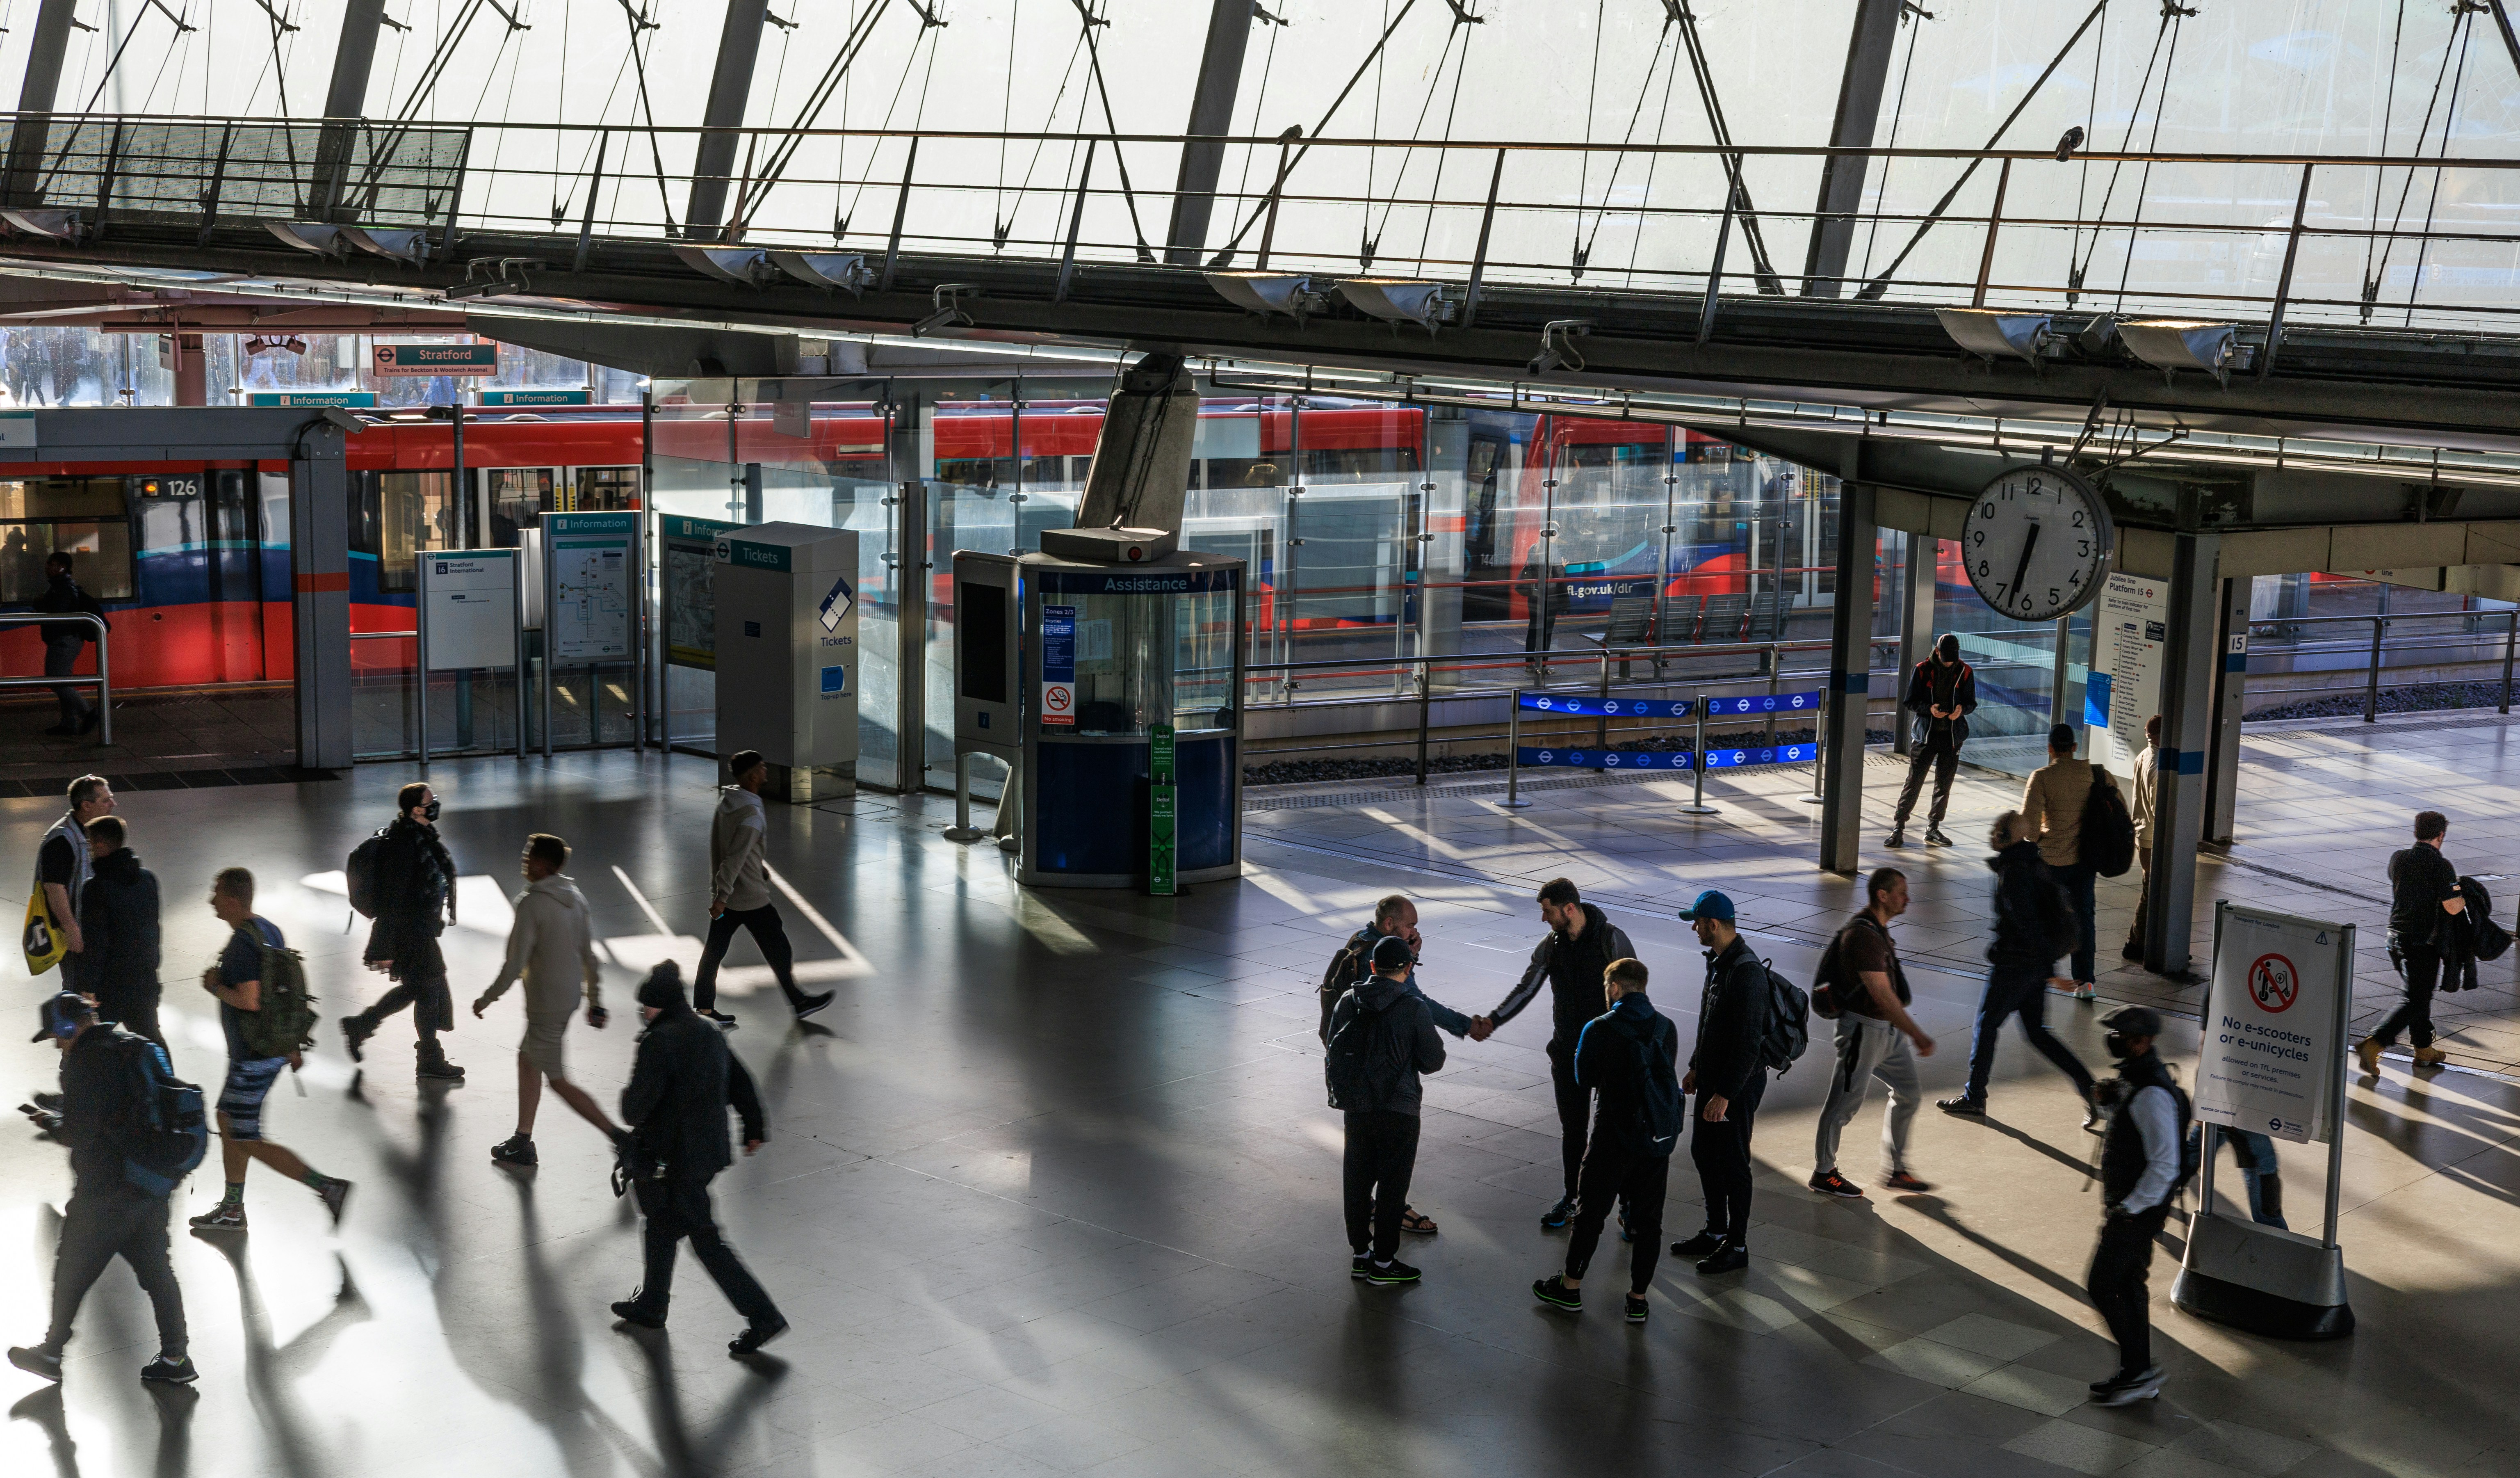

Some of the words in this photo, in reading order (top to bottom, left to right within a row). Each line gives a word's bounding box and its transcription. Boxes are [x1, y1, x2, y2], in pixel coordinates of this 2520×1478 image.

[420, 350, 471, 360] Stratford
[168, 480, 196, 496] 126
[2002, 483, 2014, 500] 11
[2027, 477, 2042, 495] 12
[2058, 487, 2062, 504] 1
[1981, 502, 1995, 519] 10
[2072, 510, 2084, 528] 2
[570, 519, 627, 528] Information
[1974, 531, 1985, 548] 9
[743, 547, 778, 564] Tickets
[2078, 540, 2089, 557] 3
[1481, 553, 1494, 567] 144
[1978, 560, 1989, 577] 8
[1104, 578, 1187, 591] Assistance
[2068, 569, 2080, 587] 4
[1567, 582, 1634, 599] fl.gov.uk/dlr
[1996, 583, 2008, 600] 7
[2048, 588, 2060, 605] 5
[2110, 583, 2136, 594] Platform
[2021, 594, 2032, 611] 6
[821, 636, 852, 647] Tickets
[2232, 637, 2243, 650] 15
[2233, 915, 2254, 924] Transport
[2222, 1016, 2241, 1030] No
[2244, 1024, 2311, 1046] e-scooters
[2219, 1034, 2234, 1044] or
[2238, 1038, 2309, 1062] e-unicycles
[2222, 1055, 2248, 1066] allowed
[2260, 1063, 2271, 1071] TfL
[2271, 1067, 2301, 1079] premises
[2250, 1072, 2279, 1083] services.
[2278, 1089, 2304, 1099] prosecution
